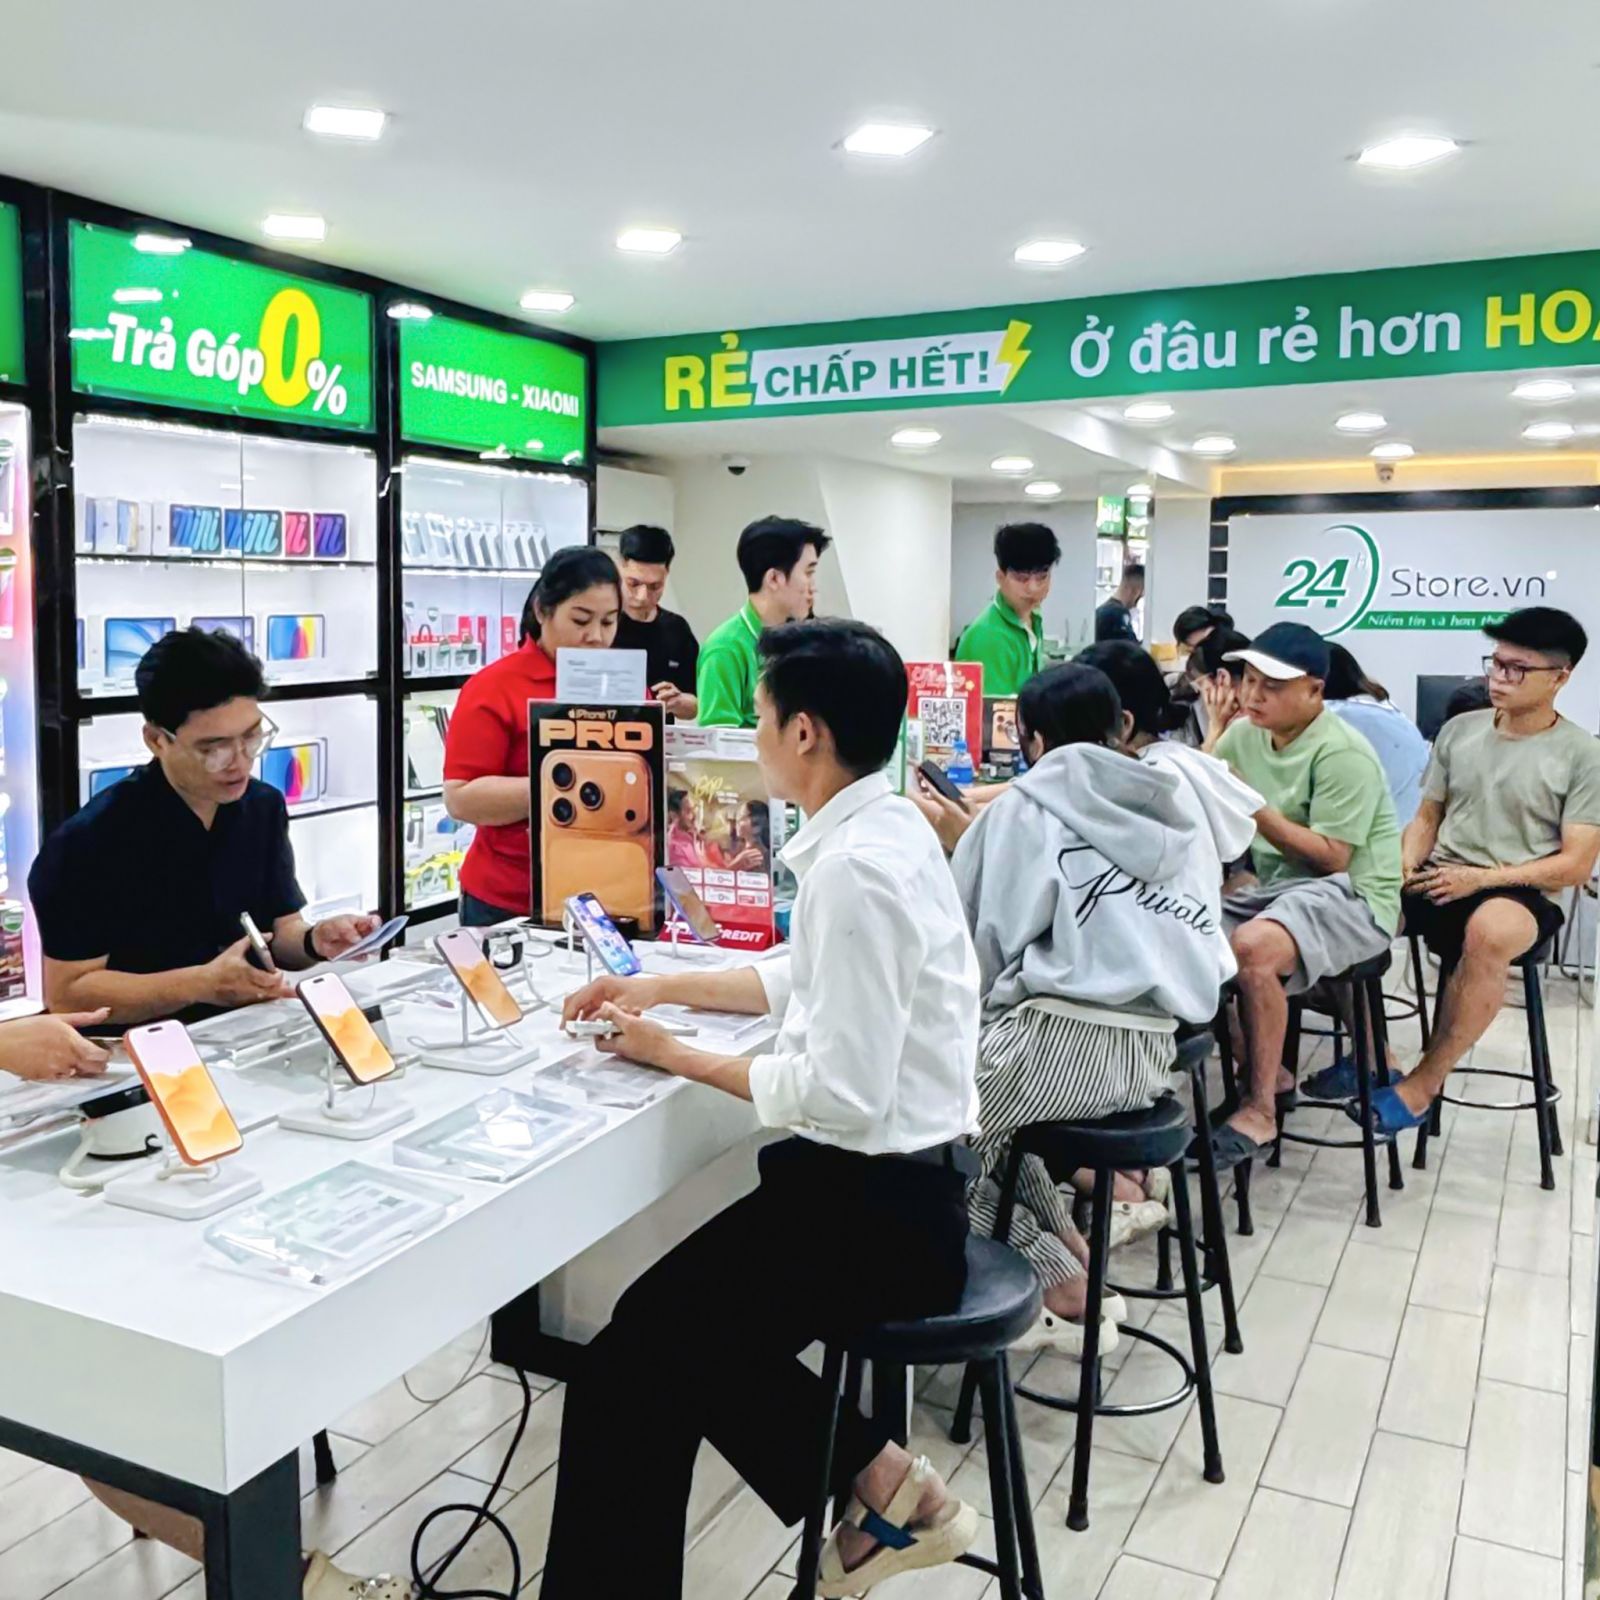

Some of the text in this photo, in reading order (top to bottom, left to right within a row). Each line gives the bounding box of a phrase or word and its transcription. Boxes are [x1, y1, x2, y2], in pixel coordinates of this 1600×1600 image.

[108, 312, 176, 371] Trả
[186, 328, 265, 395] Góp
[764, 341, 989, 398] CHẤP HẾT!
[1070, 314, 1114, 378] Ở
[1129, 319, 1237, 374] đâu
[1258, 305, 1318, 365] rẻ
[1339, 306, 1461, 359] hơn
[410, 361, 508, 405] SAMSUNG
[521, 383, 579, 418] XIAOMI
[665, 332, 753, 411] RẺ
[1390, 568, 1546, 597] Store.vn
[538, 718, 654, 751] PRO
[606, 709, 618, 721] 17
[1057, 844, 1216, 936] Private
